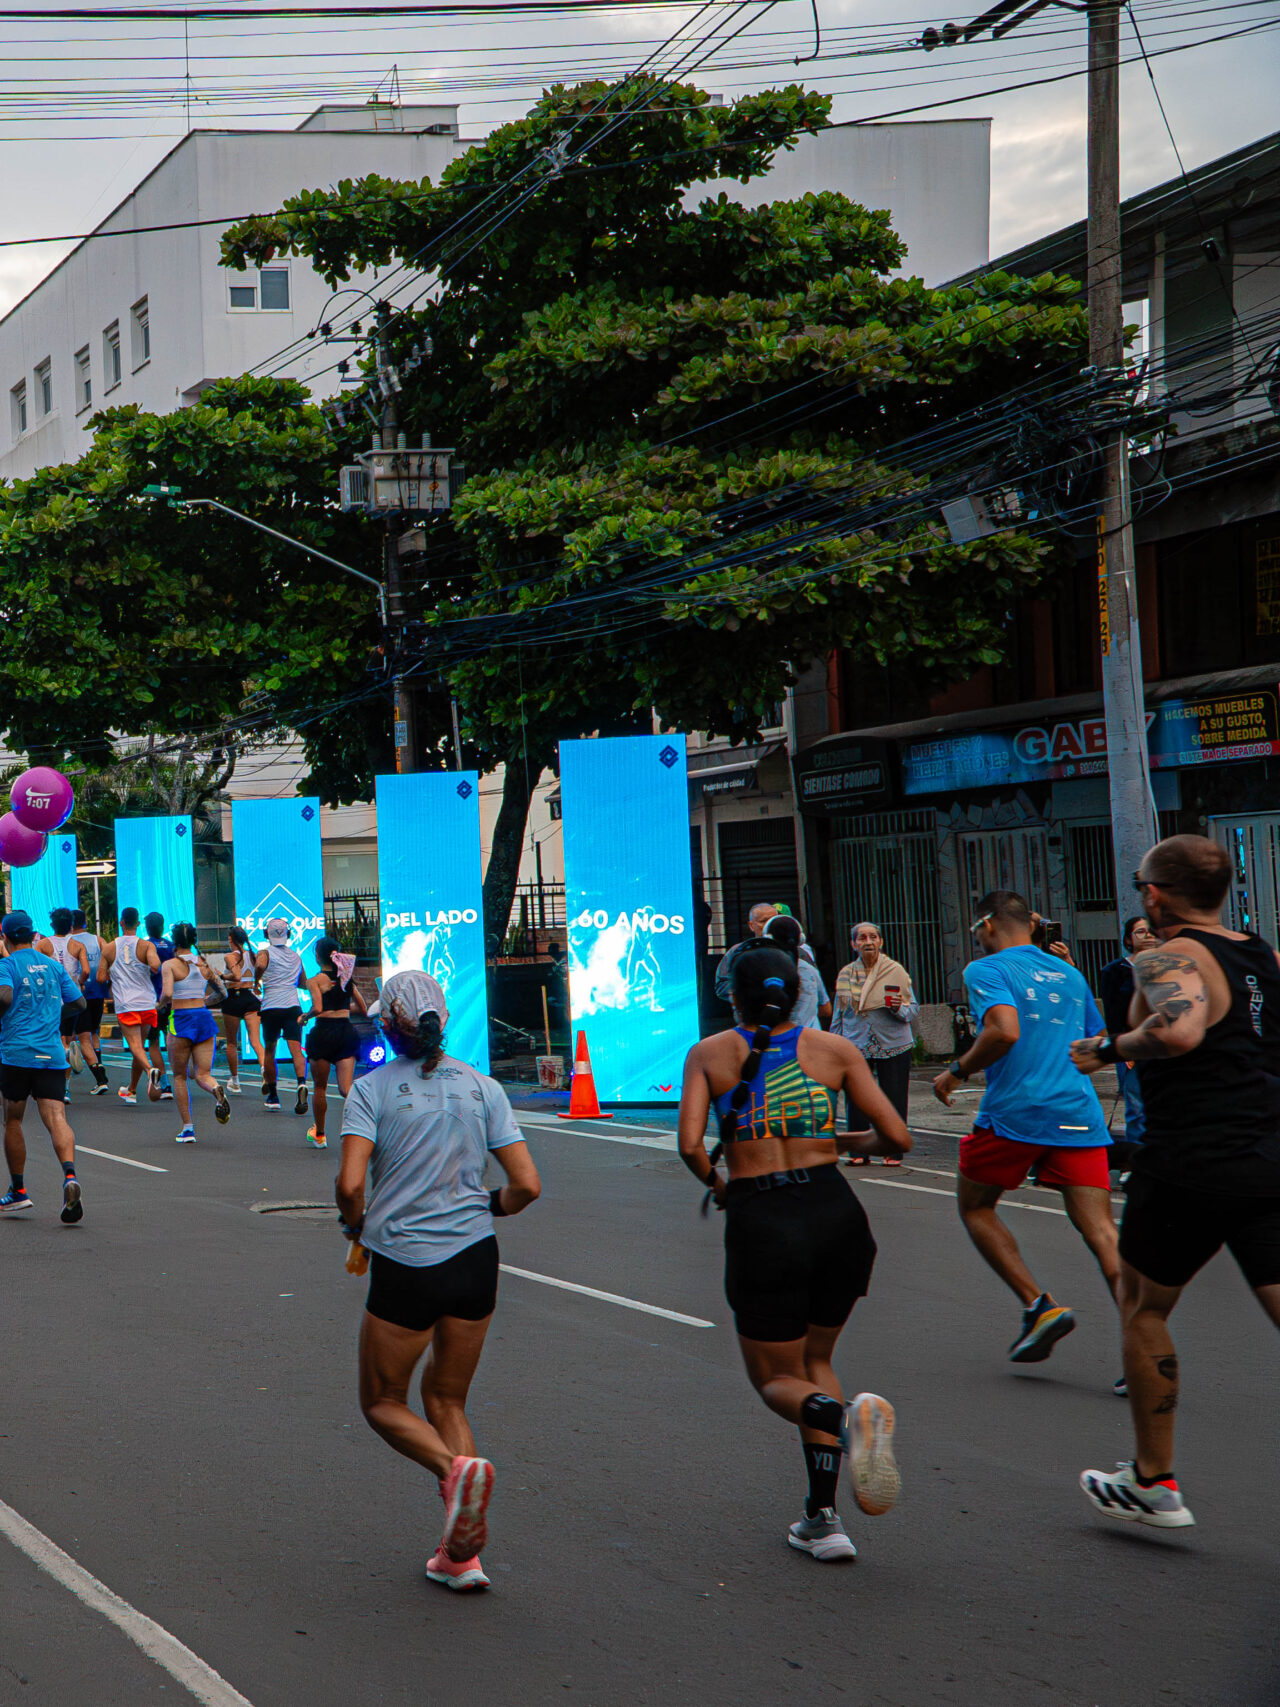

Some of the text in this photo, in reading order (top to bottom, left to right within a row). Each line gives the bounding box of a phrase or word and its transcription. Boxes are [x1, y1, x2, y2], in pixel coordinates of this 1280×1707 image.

[1164, 697, 1265, 721] HACEMOS MUEBLES
[1200, 712, 1266, 731] A SU GUSTO,
[1013, 711, 1156, 765] GAB
[1191, 726, 1267, 746] SOBRE MEDIDA
[1215, 747, 1227, 761] DE
[1227, 742, 1273, 759] SEPARADO
[803, 774, 843, 795] SIENTASE
[26, 796, 51, 809] 1:07
[236, 917, 255, 930] DE
[293, 917, 325, 931] QUE
[386, 908, 478, 929] DEL LADO
[577, 907, 685, 935] 60 AÑOS
